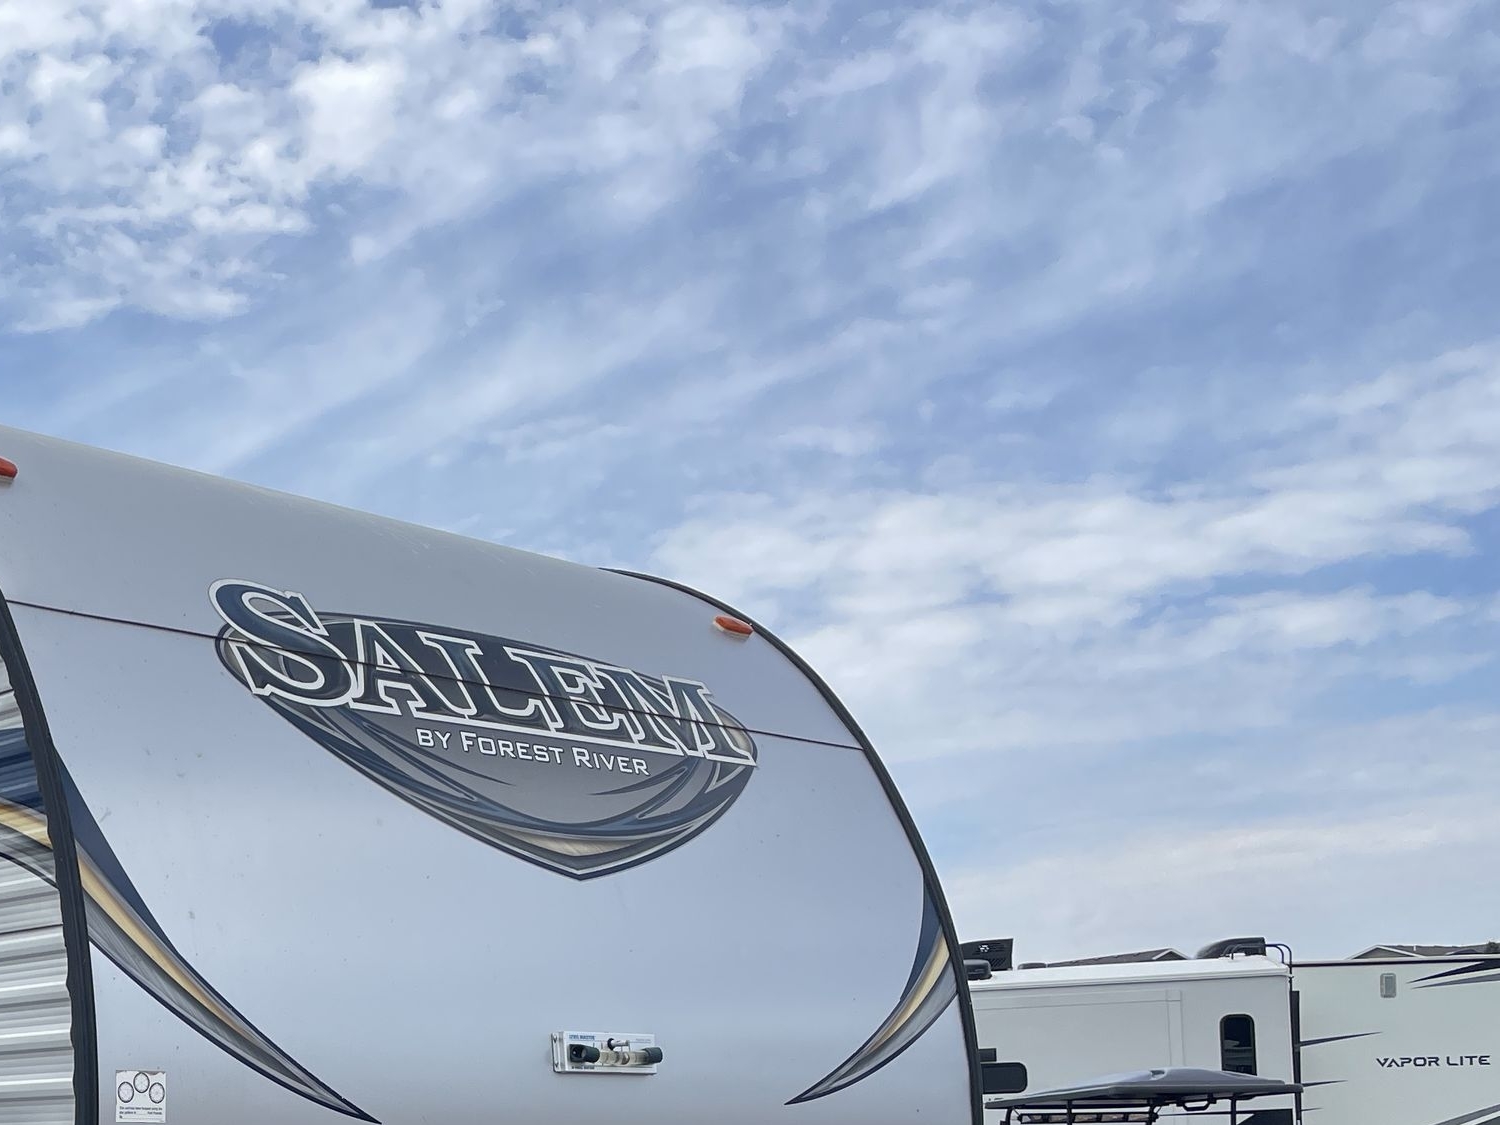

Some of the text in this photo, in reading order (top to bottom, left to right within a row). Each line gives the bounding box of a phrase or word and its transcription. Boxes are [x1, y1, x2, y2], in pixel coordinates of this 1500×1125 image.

[208, 578, 758, 768] SALEM
[416, 728, 651, 776] BY FOREST RIVER
[1375, 1054, 1491, 1068] VAPOR LITE
